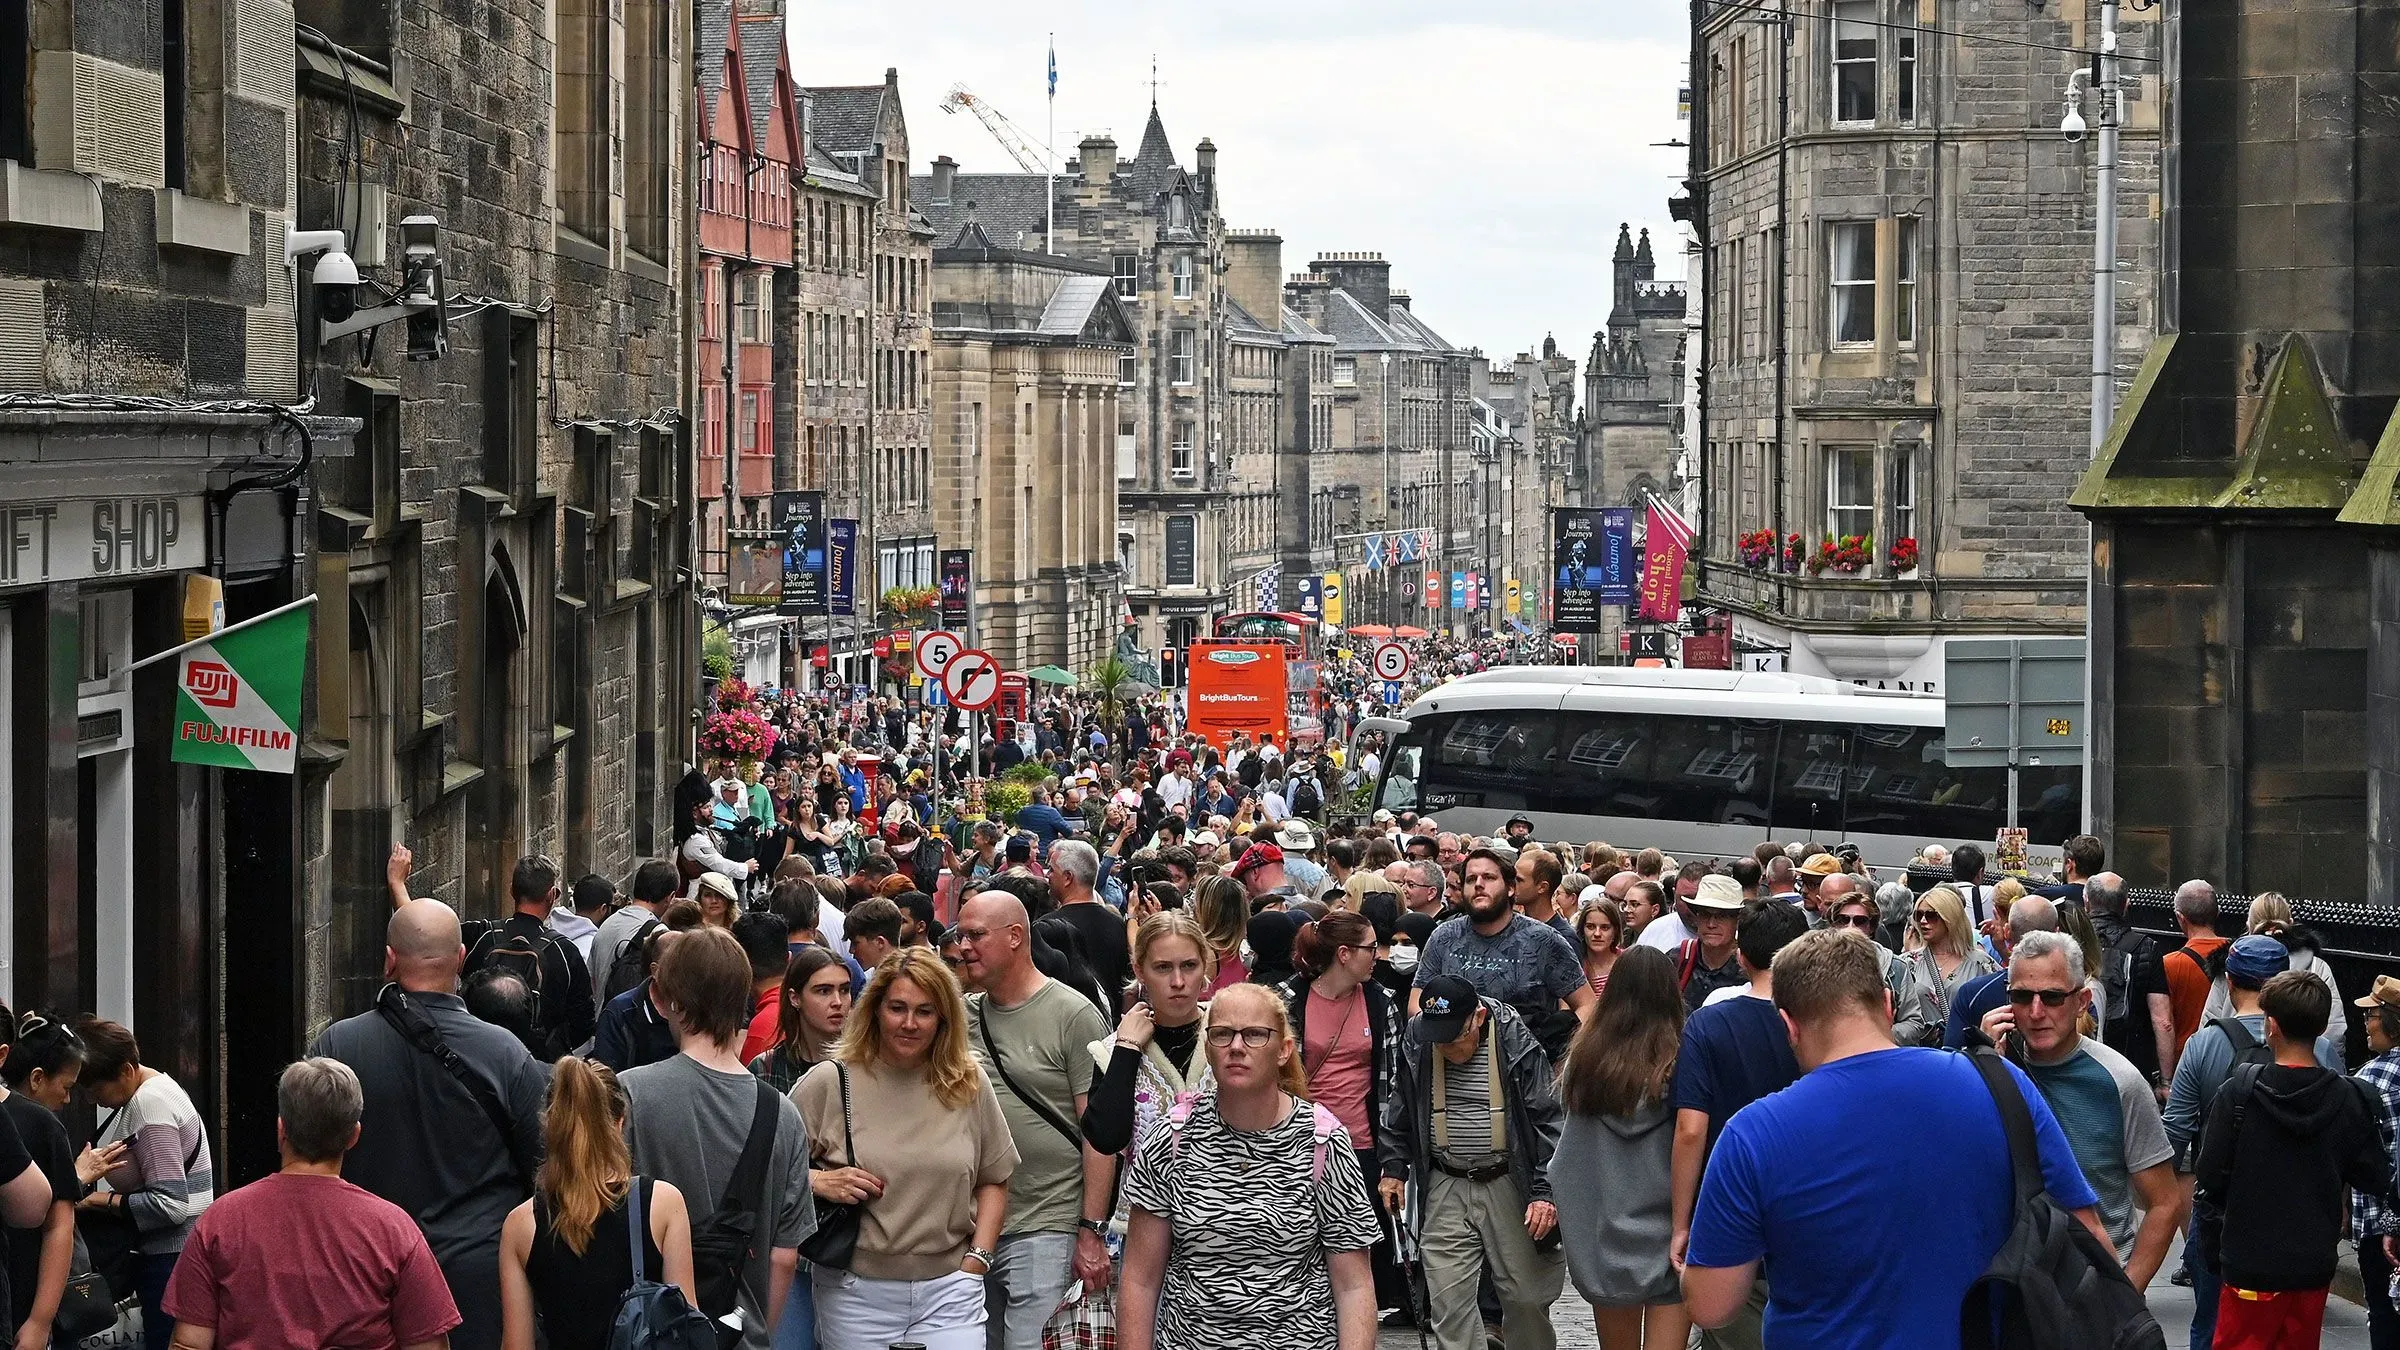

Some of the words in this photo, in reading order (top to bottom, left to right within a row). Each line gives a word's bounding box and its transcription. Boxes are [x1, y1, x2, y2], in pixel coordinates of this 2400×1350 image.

[783, 513, 813, 524] Journeys
[0, 503, 57, 585] IFT
[92, 498, 180, 576] SHOP
[1563, 528, 1593, 541] Journeys
[1606, 530, 1623, 583] Journeys
[1664, 543, 1676, 579] National
[831, 541, 846, 592] Journeys
[785, 571, 799, 581] Step
[800, 571, 813, 580] into
[1643, 552, 1666, 602] Shop
[784, 580, 815, 589] adventure
[1562, 587, 1577, 598] Step
[1578, 588, 1591, 598] into
[1562, 596, 1593, 606] adventure
[1658, 583, 1672, 615] Library
[1641, 635, 1654, 651] K
[933, 644, 948, 664] 5
[1211, 652, 1229, 660] Bright
[1385, 653, 1397, 670] 5
[1756, 658, 1772, 672] K
[186, 662, 236, 698] FUJI
[825, 675, 839, 685] 20
[180, 720, 292, 750] FUJIFILM
